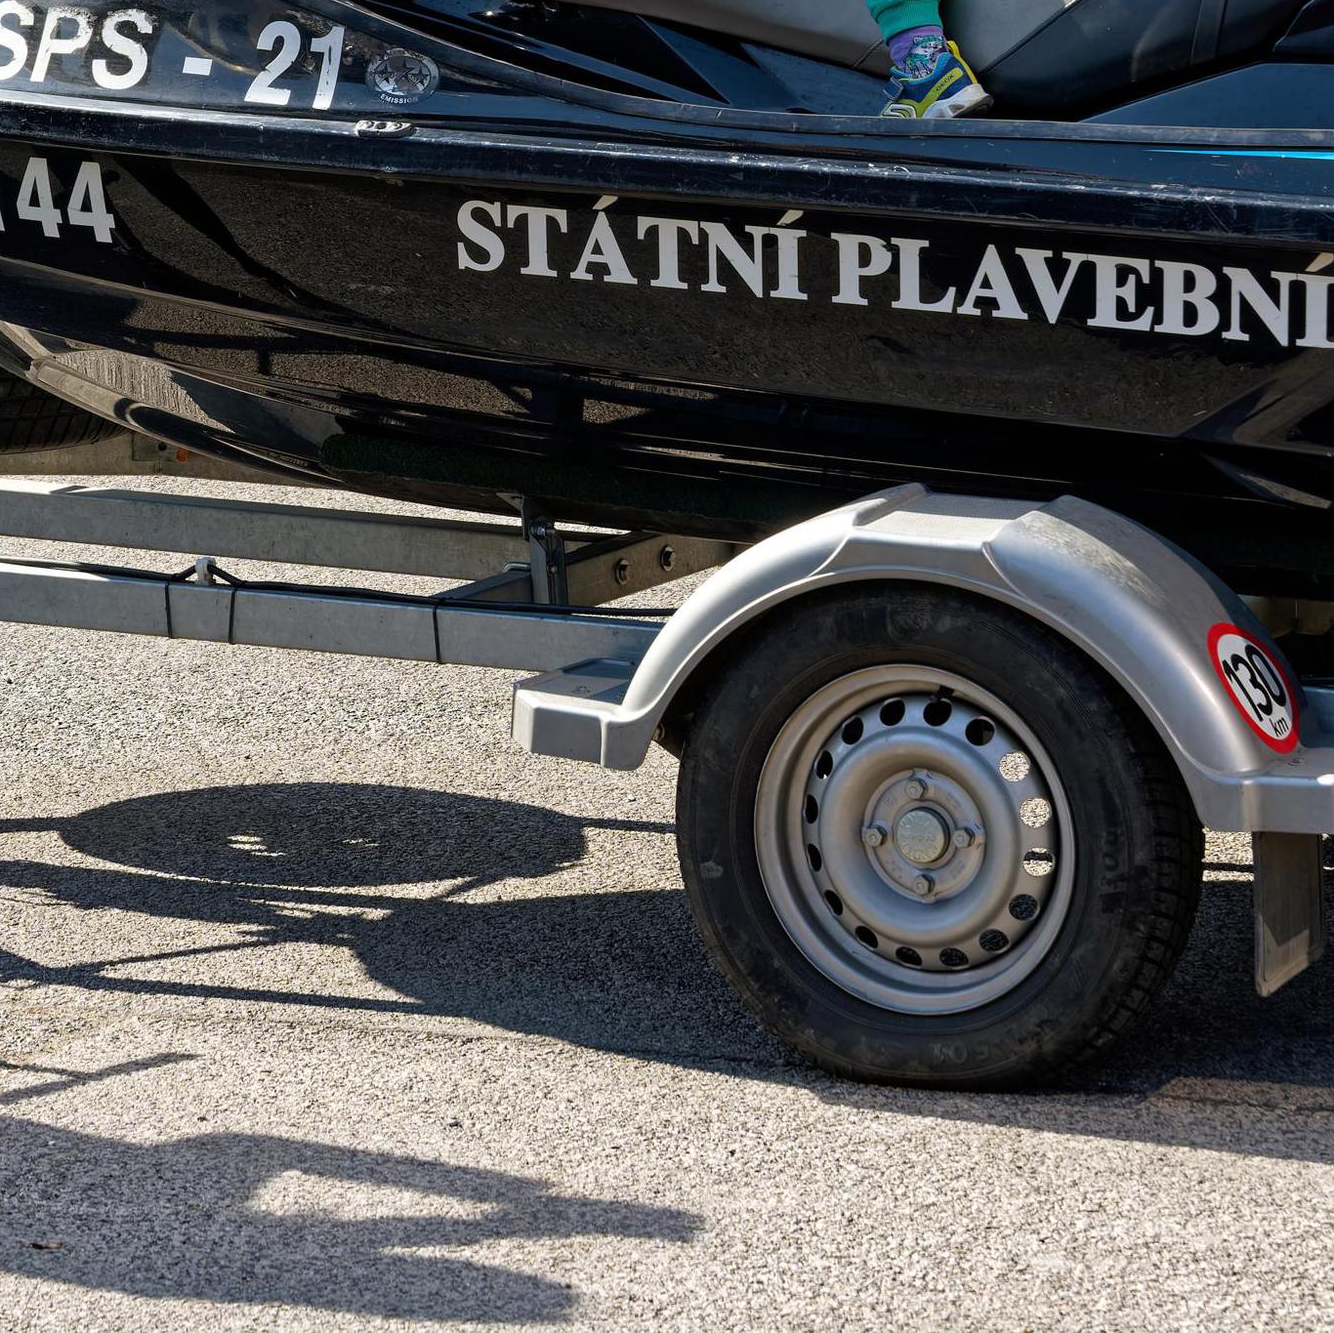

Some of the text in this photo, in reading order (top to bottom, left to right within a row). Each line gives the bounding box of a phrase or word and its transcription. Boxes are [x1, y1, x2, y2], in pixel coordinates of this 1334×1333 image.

[244, 20, 346, 110] 21
[457, 195, 808, 299] STÁTNÍ
[1222, 644, 1288, 722] 130
[1269, 717, 1290, 738] km
